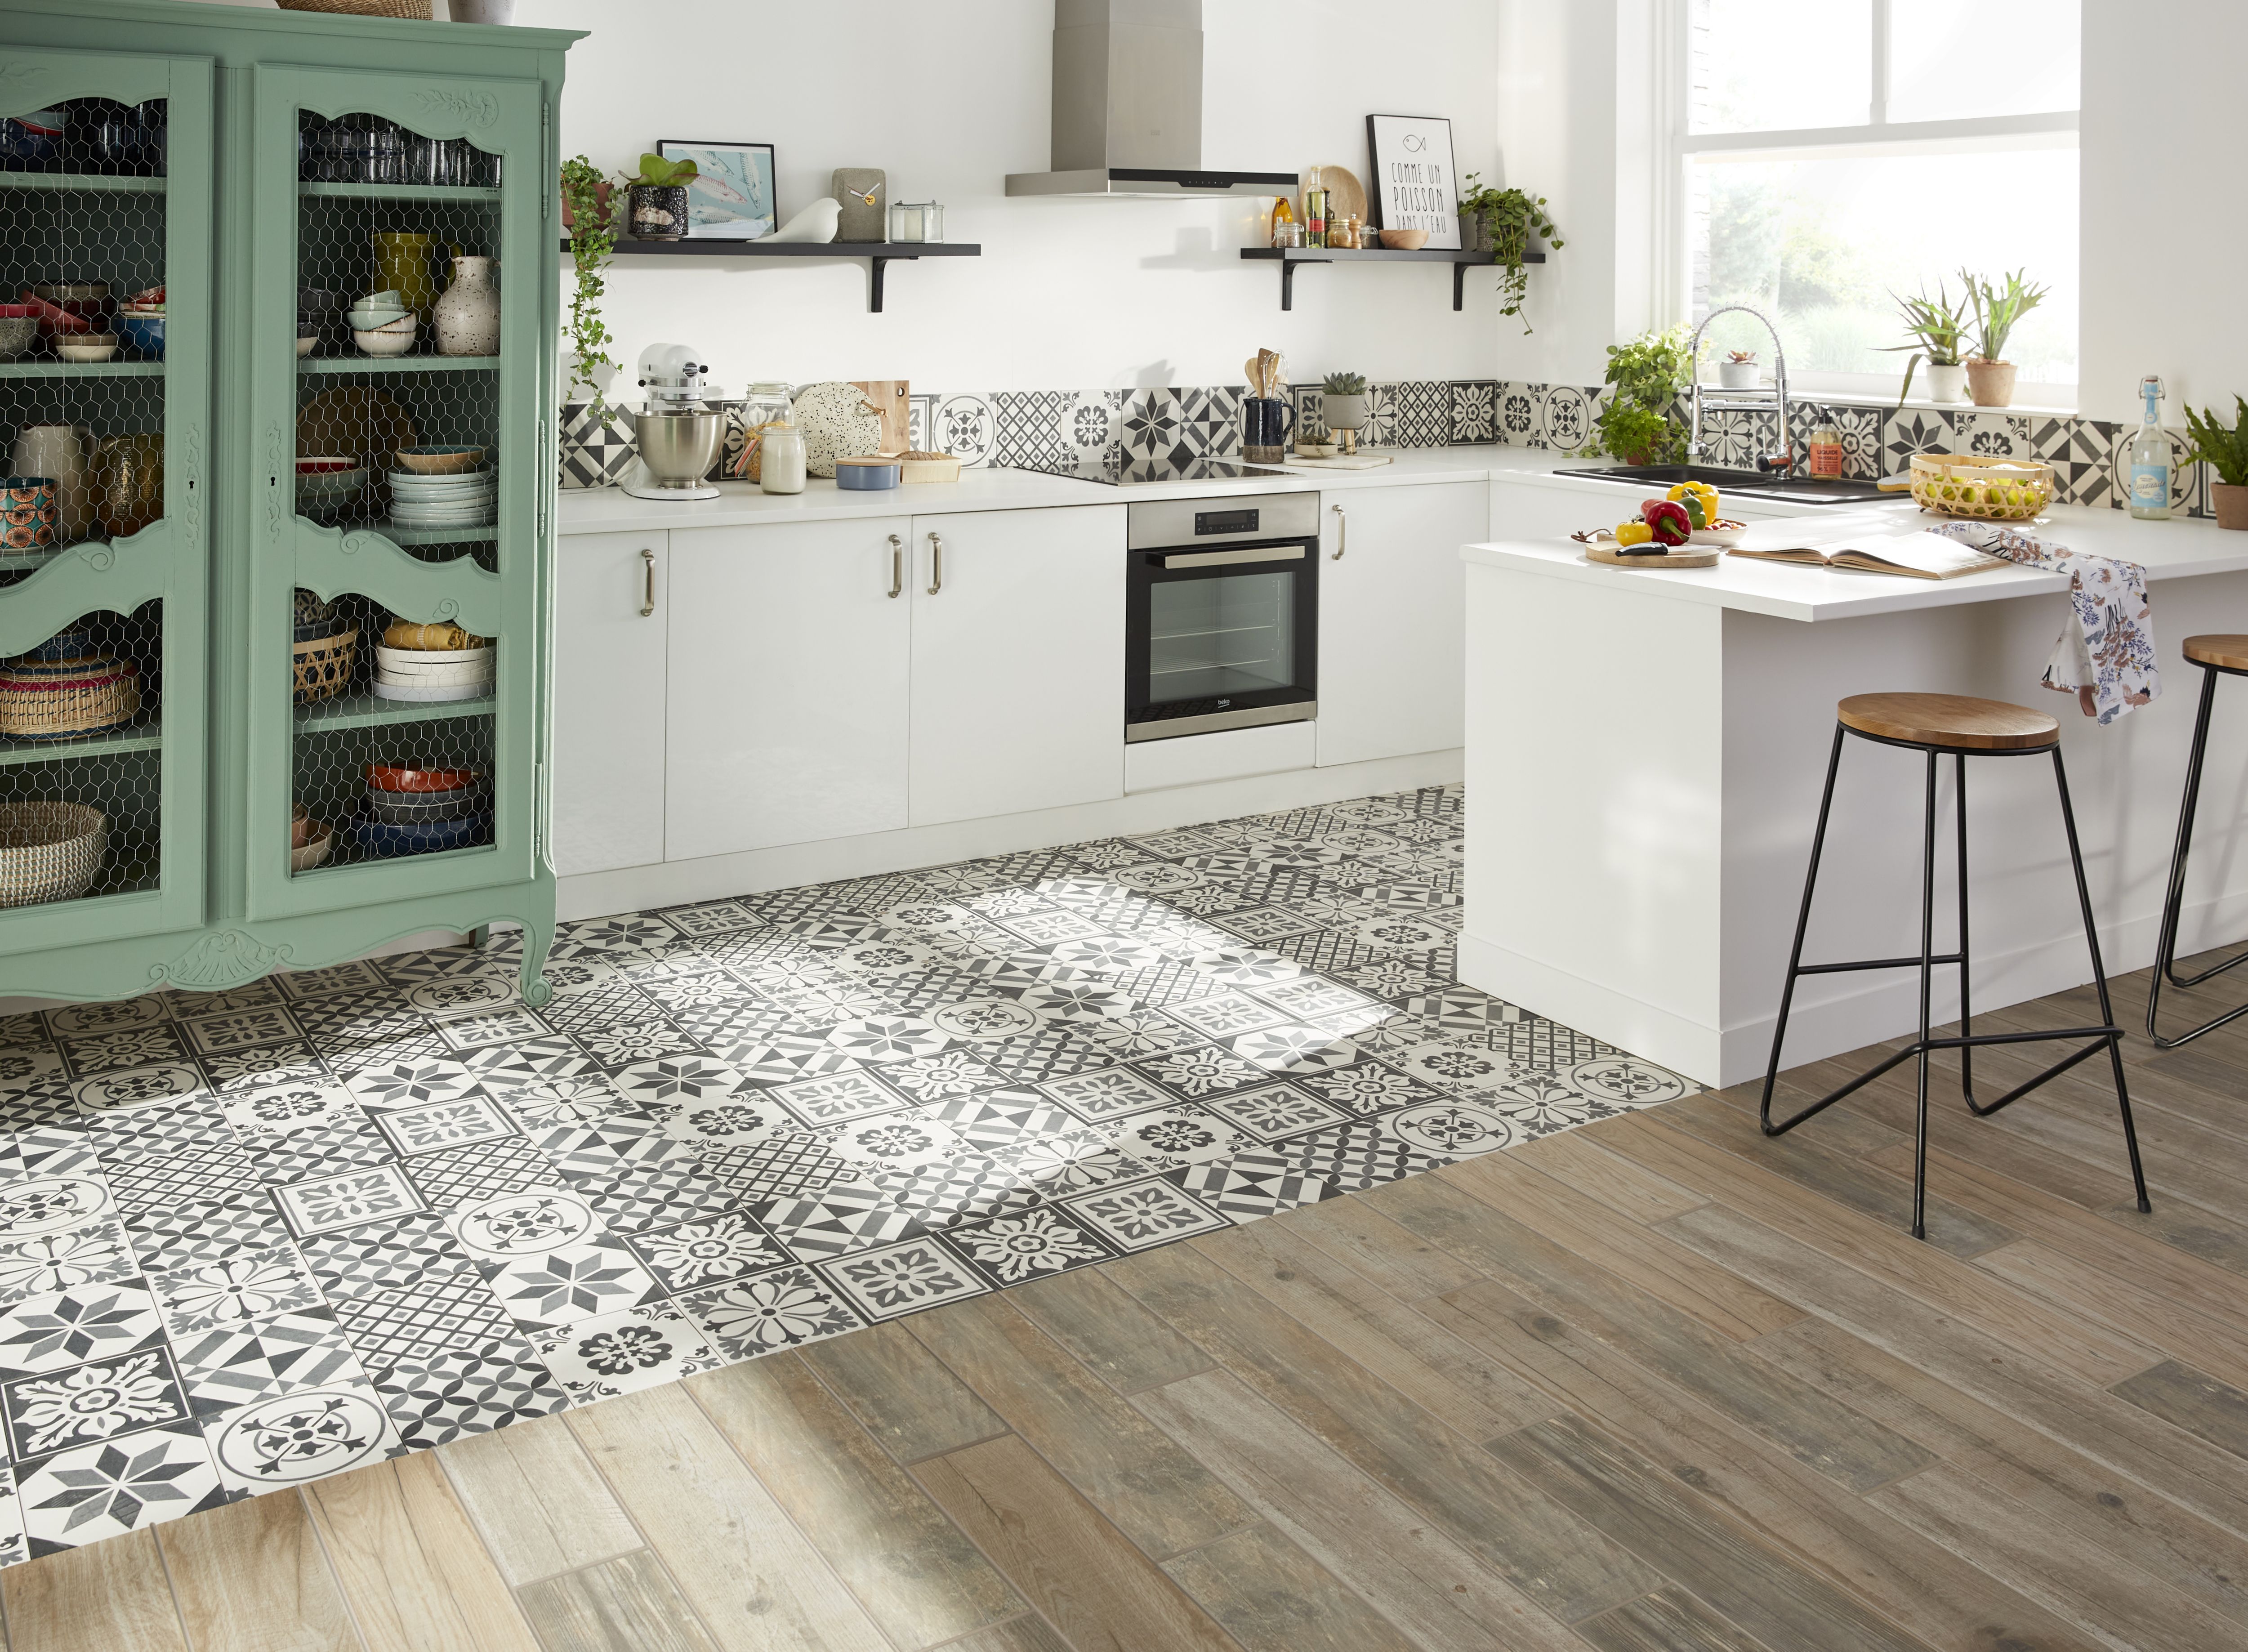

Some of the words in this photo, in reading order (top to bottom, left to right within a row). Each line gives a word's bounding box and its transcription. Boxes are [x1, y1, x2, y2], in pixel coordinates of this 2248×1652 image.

[1392, 163, 1423, 183] COMME
[1428, 165, 1441, 184] UN
[1394, 187, 1443, 212] POISSON
[1396, 215, 1417, 230] DANS
[2132, 479, 2166, 493] Lemonade
